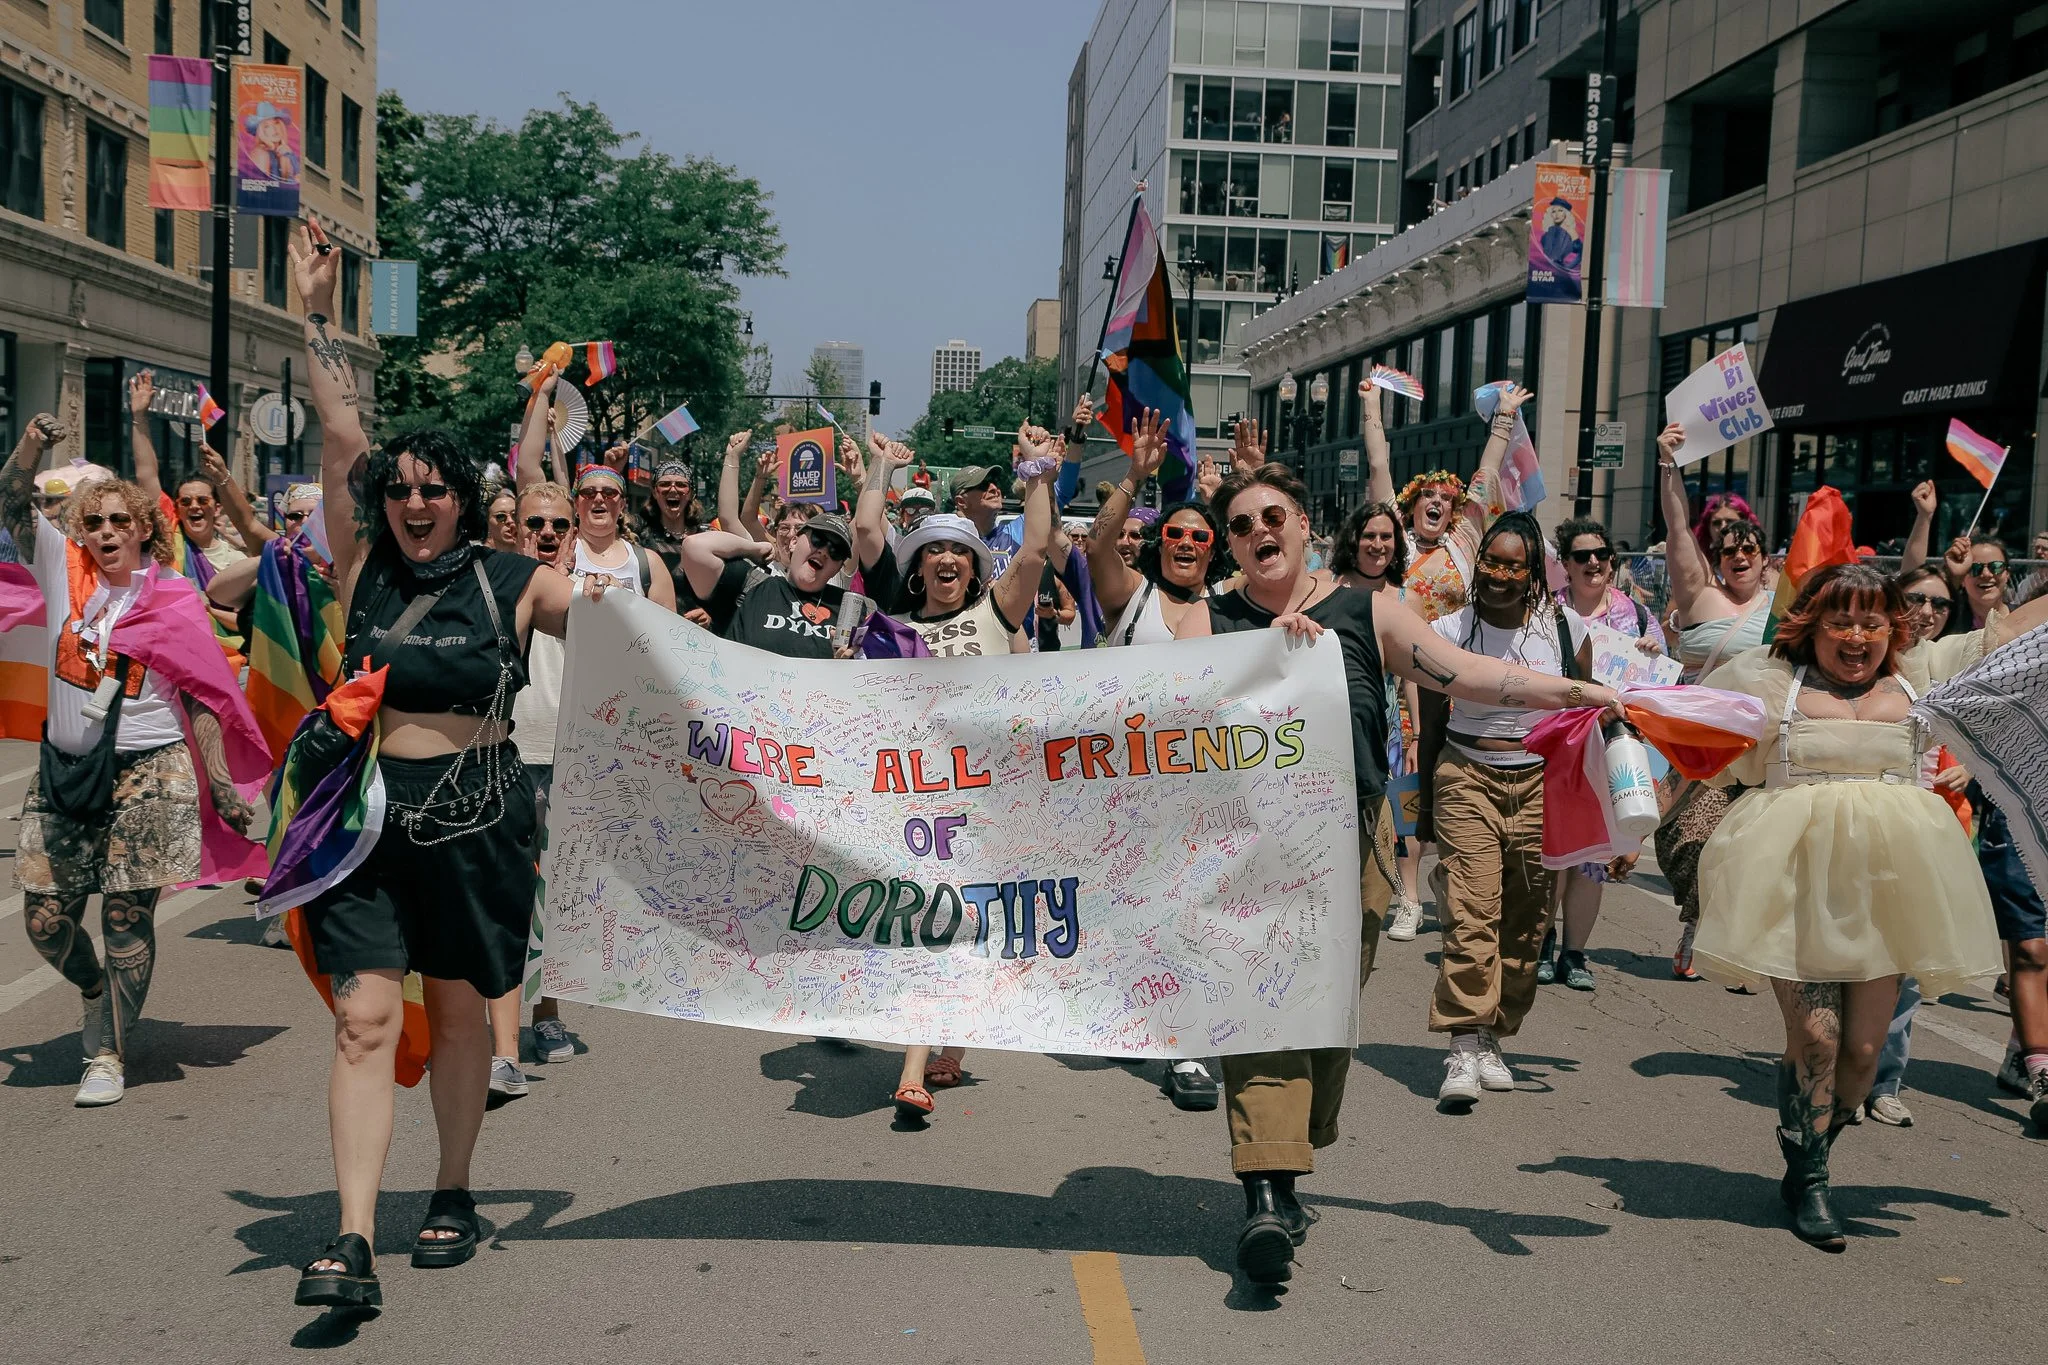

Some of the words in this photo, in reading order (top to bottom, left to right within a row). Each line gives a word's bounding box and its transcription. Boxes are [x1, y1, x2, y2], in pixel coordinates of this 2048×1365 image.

[237, 0, 250, 54] 834
[241, 75, 297, 88] MARKET
[264, 86, 297, 97] DAYS
[1586, 73, 1602, 164] BR3827
[1539, 174, 1587, 185] MARKET
[1558, 184, 1587, 194] DAYS
[390, 262, 399, 330] REMARKABLE
[1714, 351, 1744, 371] The
[1723, 366, 1743, 390] Bi
[1902, 388, 1928, 405] CRAFT
[1929, 384, 1952, 401] MADE
[1953, 380, 1988, 399] DRINKS
[1699, 386, 1756, 422] Wives
[1781, 404, 1805, 419] EVENTS
[1719, 408, 1763, 440] Club
[793, 471, 820, 480] ALLIED
[793, 479, 819, 488] SPACE
[614, 737, 644, 754] Protect
[632, 757, 648, 767] kids
[872, 746, 992, 793] ALL
[903, 812, 968, 860] OF
[643, 909, 664, 918] NEVER
[788, 864, 1080, 960] DOROTHY
[892, 959, 918, 968] Emma
